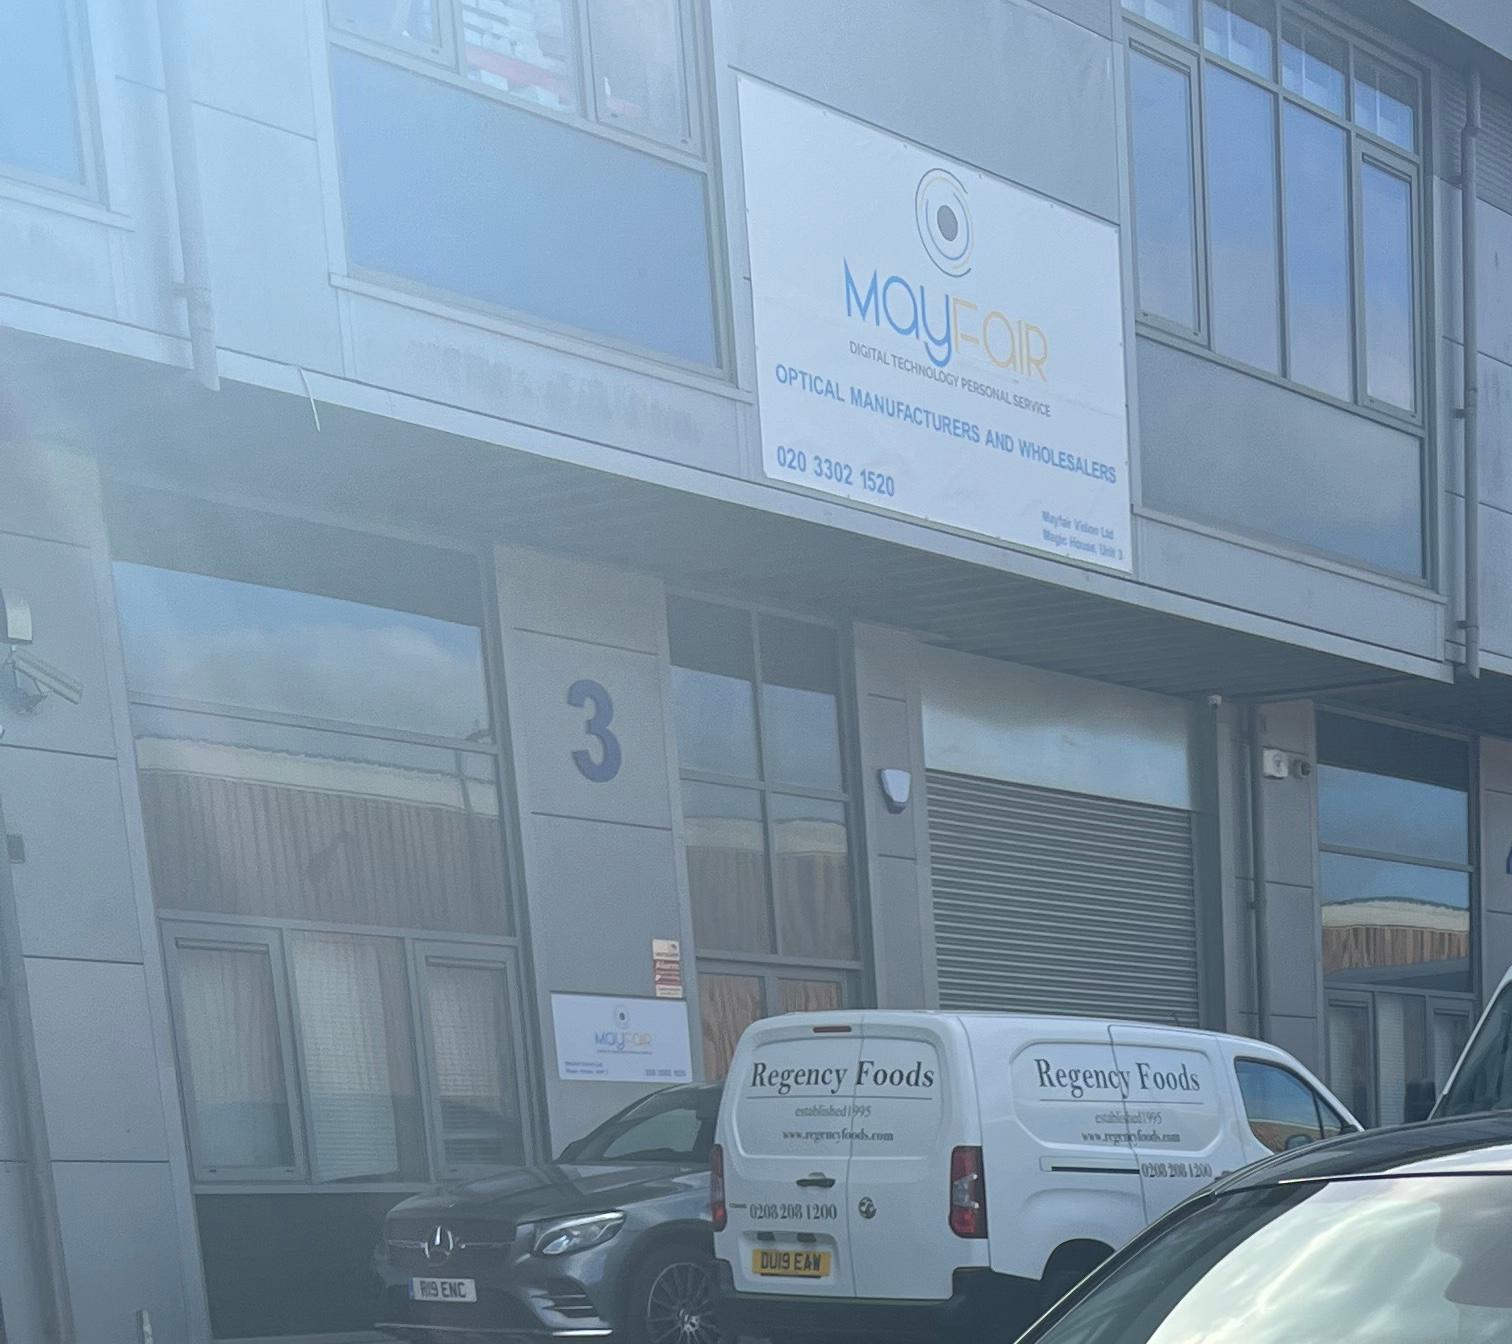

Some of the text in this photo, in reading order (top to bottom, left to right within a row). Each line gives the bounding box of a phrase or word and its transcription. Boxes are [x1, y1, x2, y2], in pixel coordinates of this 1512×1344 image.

[850, 340, 1052, 418] DIGITAL TECHNOLOGY PERSONAL SERVICE
[776, 363, 1117, 484] OPTICAL MANUFACTURERS AND WHOLESALERS
[777, 445, 896, 497] 020 3302 1520
[566, 679, 622, 783] 3
[750, 1060, 935, 1095] Regency Foods
[1034, 1058, 1201, 1099] Regency Foods
[782, 1128, 894, 1143] www.regencyfoods.com
[749, 1203, 838, 1219] 0208 208 1200
[760, 1251, 790, 1270] DU19
[440, 1281, 467, 1299] ENC
